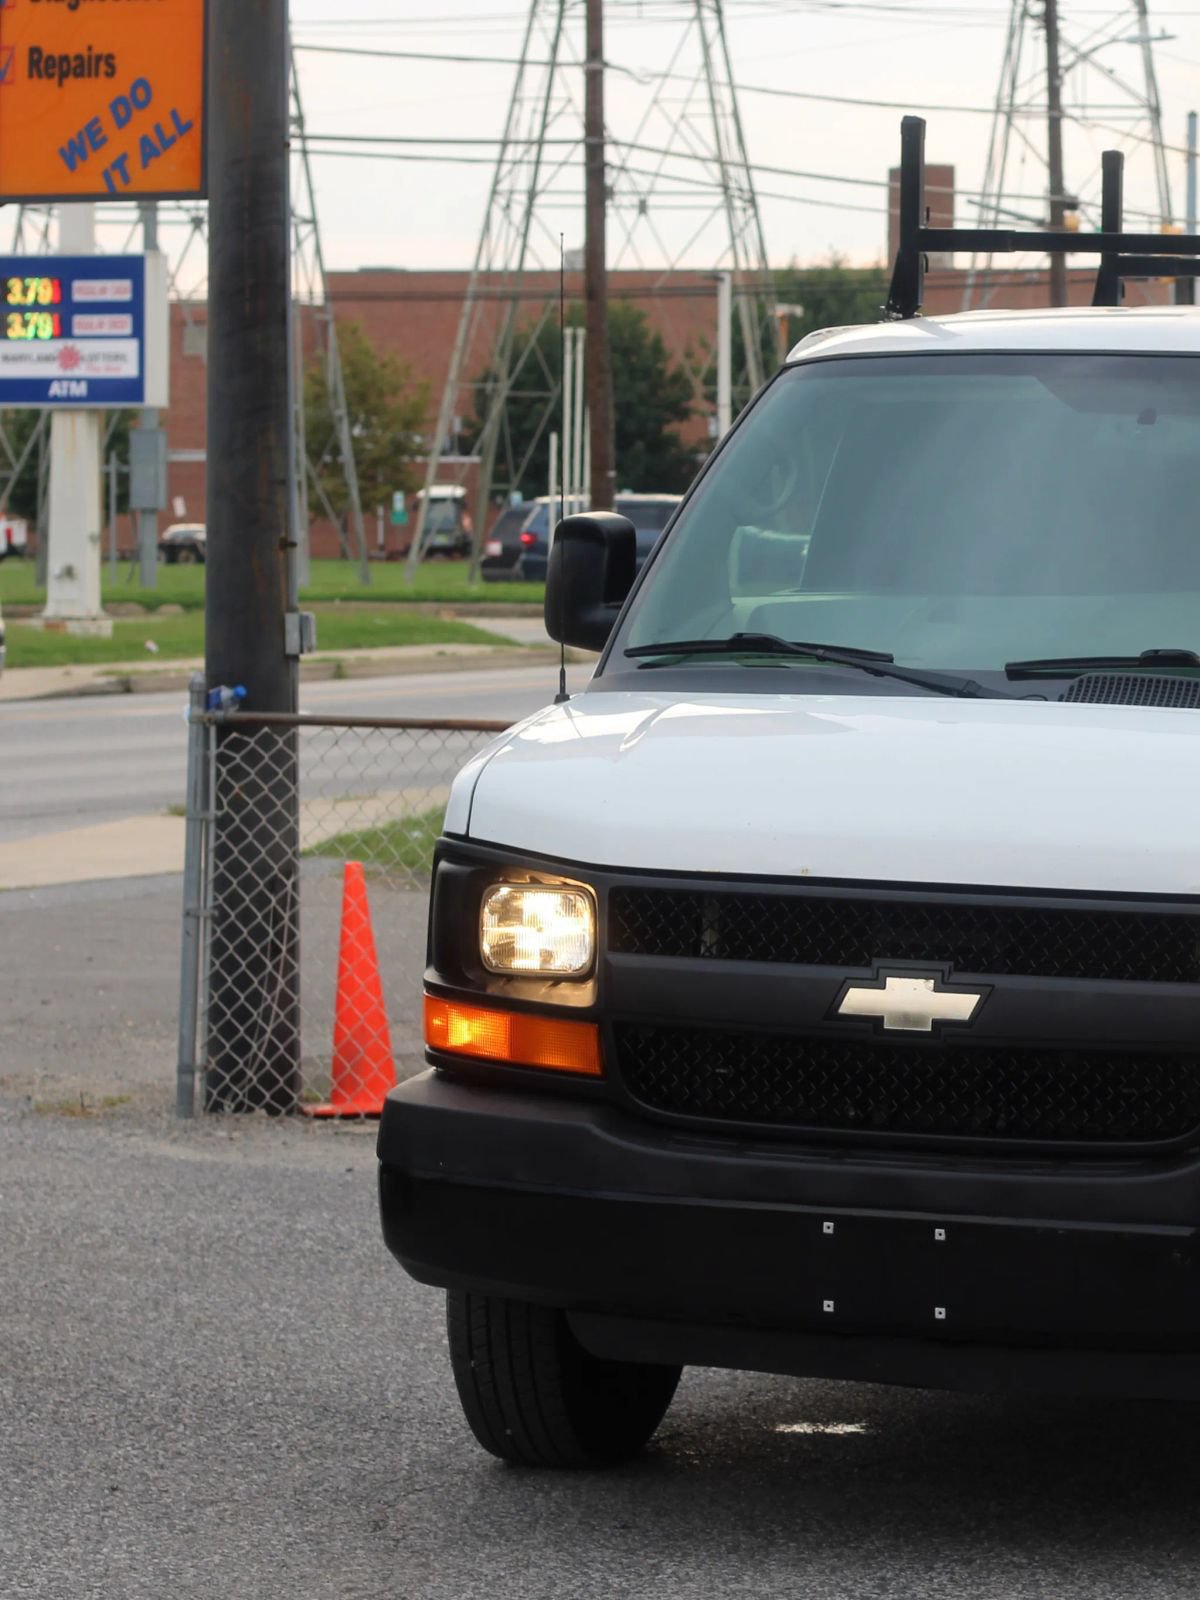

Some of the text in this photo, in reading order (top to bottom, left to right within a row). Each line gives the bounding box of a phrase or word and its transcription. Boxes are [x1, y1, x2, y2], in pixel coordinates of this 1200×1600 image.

[28, 46, 116, 87] Repairs
[58, 77, 152, 173] WE DO
[102, 108, 193, 193] IT ALL
[48, 381, 88, 397] ATM
